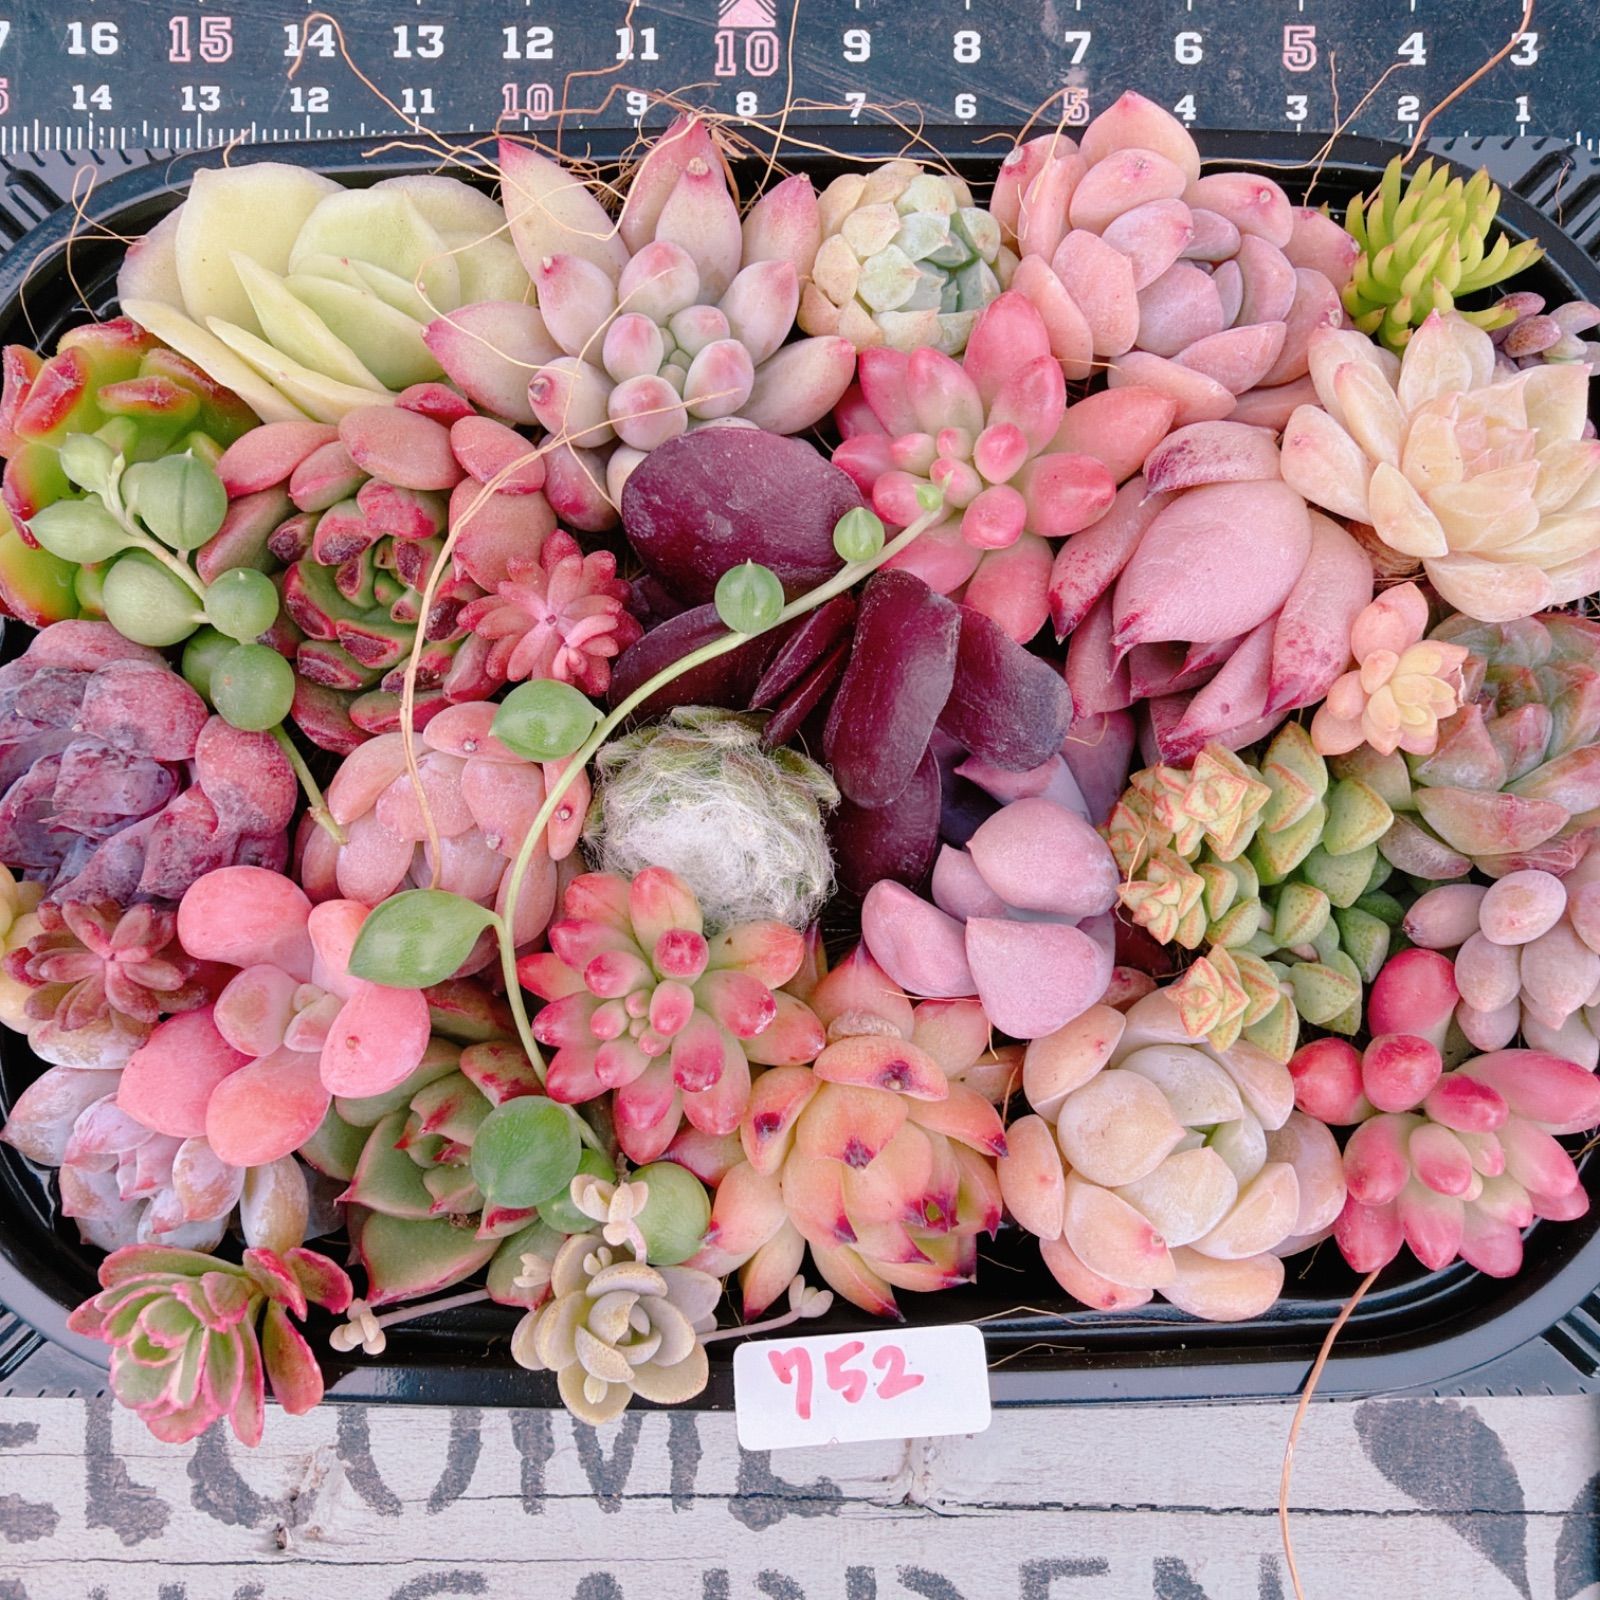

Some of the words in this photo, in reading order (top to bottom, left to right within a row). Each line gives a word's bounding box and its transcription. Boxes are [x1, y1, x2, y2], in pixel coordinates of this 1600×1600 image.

[67, 22, 119, 54] 16
[169, 17, 232, 62] 15
[284, 24, 335, 57] 14
[393, 25, 445, 58] 13
[503, 26, 554, 59] 12
[615, 28, 659, 61] 11
[714, 31, 779, 76] 10
[843, 30, 872, 62] 9
[953, 31, 982, 63] 8
[1065, 32, 1091, 64] 7
[1174, 33, 1203, 65] 6
[1283, 25, 1316, 72] 5
[1398, 32, 1427, 66] 4
[1510, 33, 1540, 66] 3
[72, 85, 112, 110] 14
[181, 86, 221, 111] 13
[290, 87, 329, 112] 12
[402, 89, 435, 113] 11
[502, 84, 554, 120] 10
[626, 91, 648, 116] 9
[735, 91, 758, 117] 8
[846, 93, 866, 118] 7
[954, 94, 977, 119] 6
[1062, 88, 1089, 125] 5
[1174, 95, 1196, 120] 4
[1286, 95, 1308, 121] 3
[1397, 95, 1420, 121] 2
[1515, 97, 1530, 122] 1
[768, 1341, 925, 1420] 752
